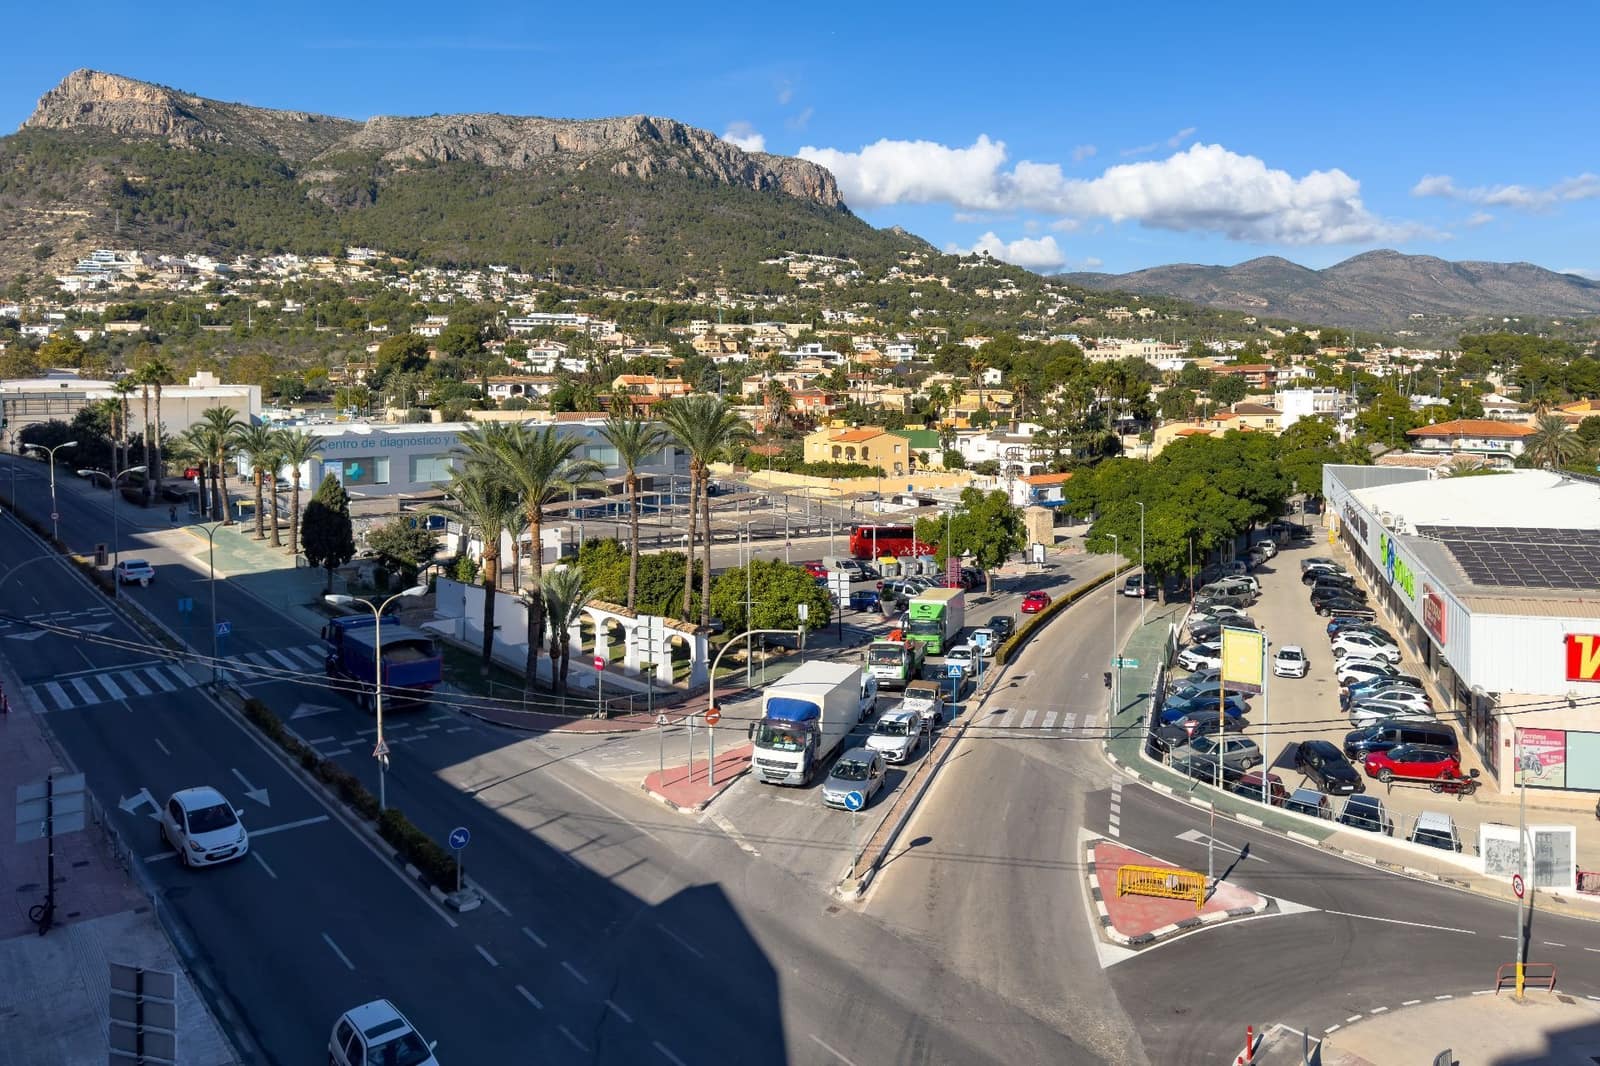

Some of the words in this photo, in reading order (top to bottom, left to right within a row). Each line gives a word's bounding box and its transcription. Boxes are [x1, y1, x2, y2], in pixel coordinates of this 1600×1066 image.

[319, 439, 358, 449] Centro
[361, 437, 376, 447] de
[444, 436, 450, 446] y
